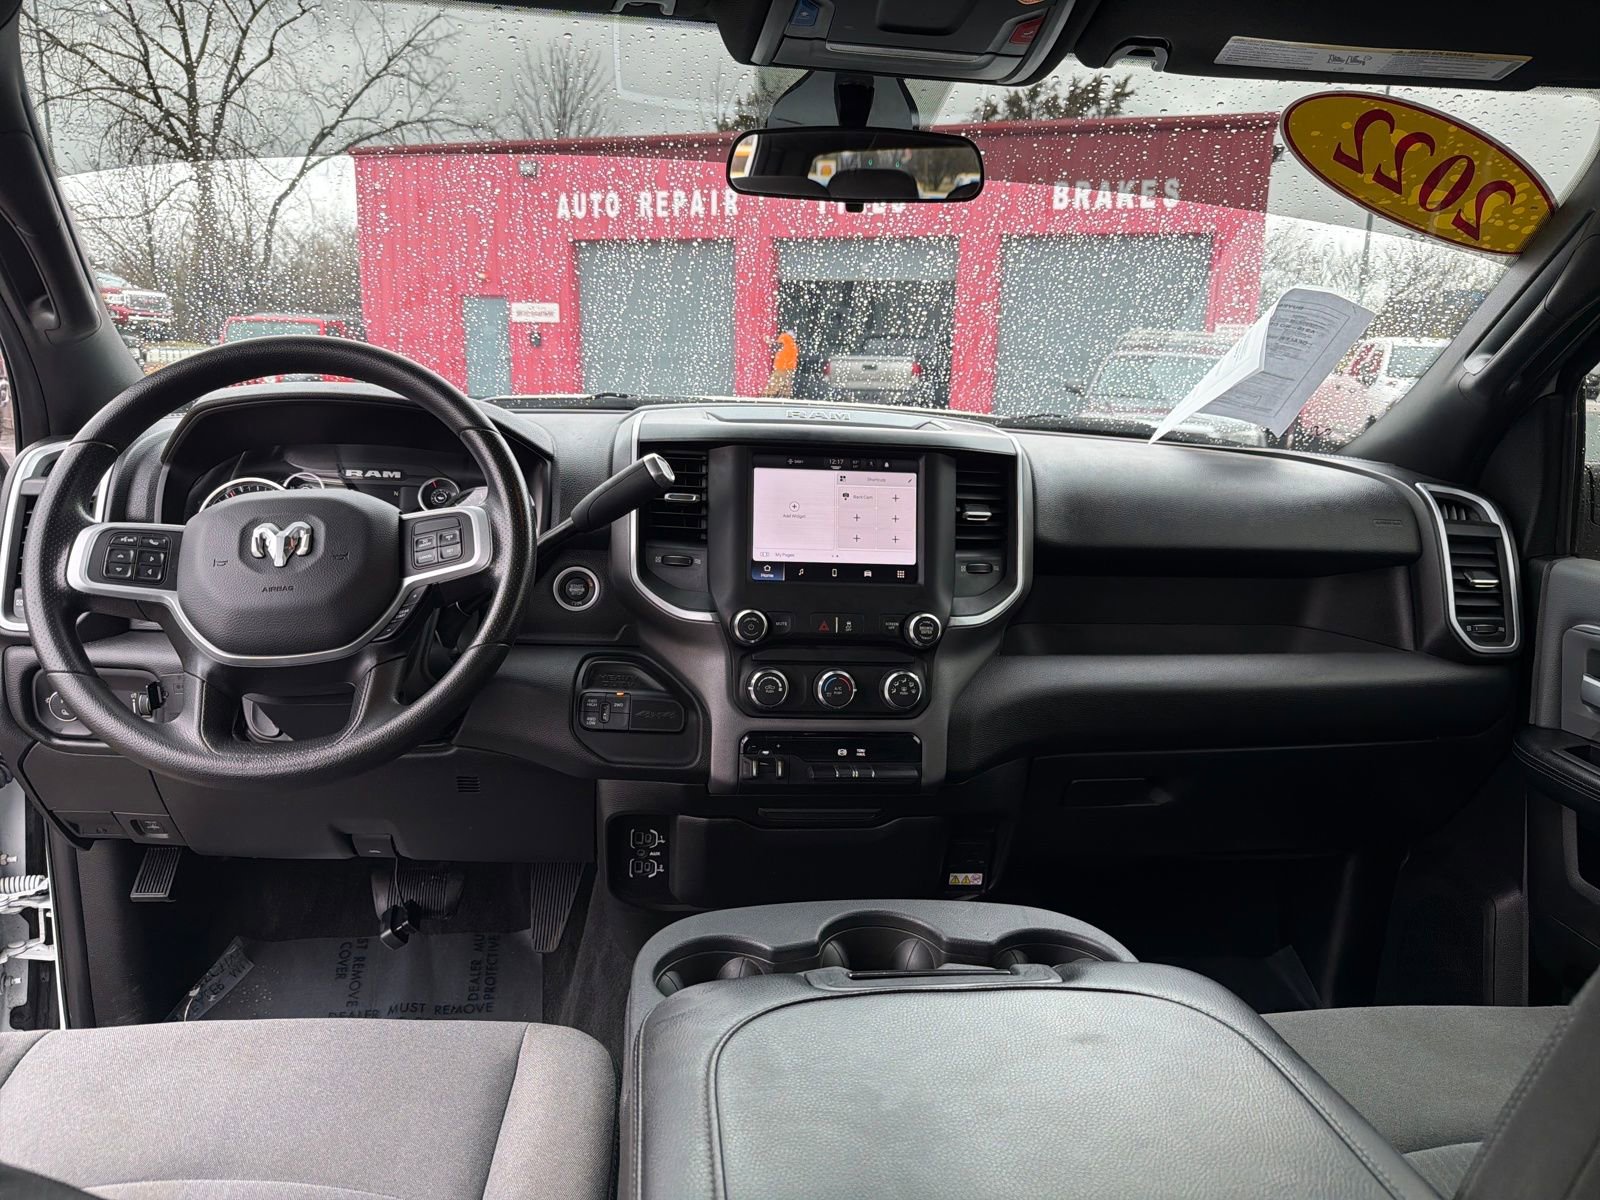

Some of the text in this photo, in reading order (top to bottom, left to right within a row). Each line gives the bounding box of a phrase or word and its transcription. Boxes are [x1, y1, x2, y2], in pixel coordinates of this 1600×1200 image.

[556, 188, 740, 219] AUTO REPAIR
[1053, 179, 1180, 209] BRAKES
[786, 410, 851, 421] RAM
[344, 469, 401, 479] RAM
[261, 585, 295, 593] AIRBAG
[334, 942, 353, 981] COVER
[483, 935, 503, 1001] PROTECTIVE
[346, 956, 368, 1008] REMOVE
[467, 959, 484, 1002] DEALER
[387, 1002, 428, 1017] MUST
[434, 1002, 495, 1016] REMOVE
